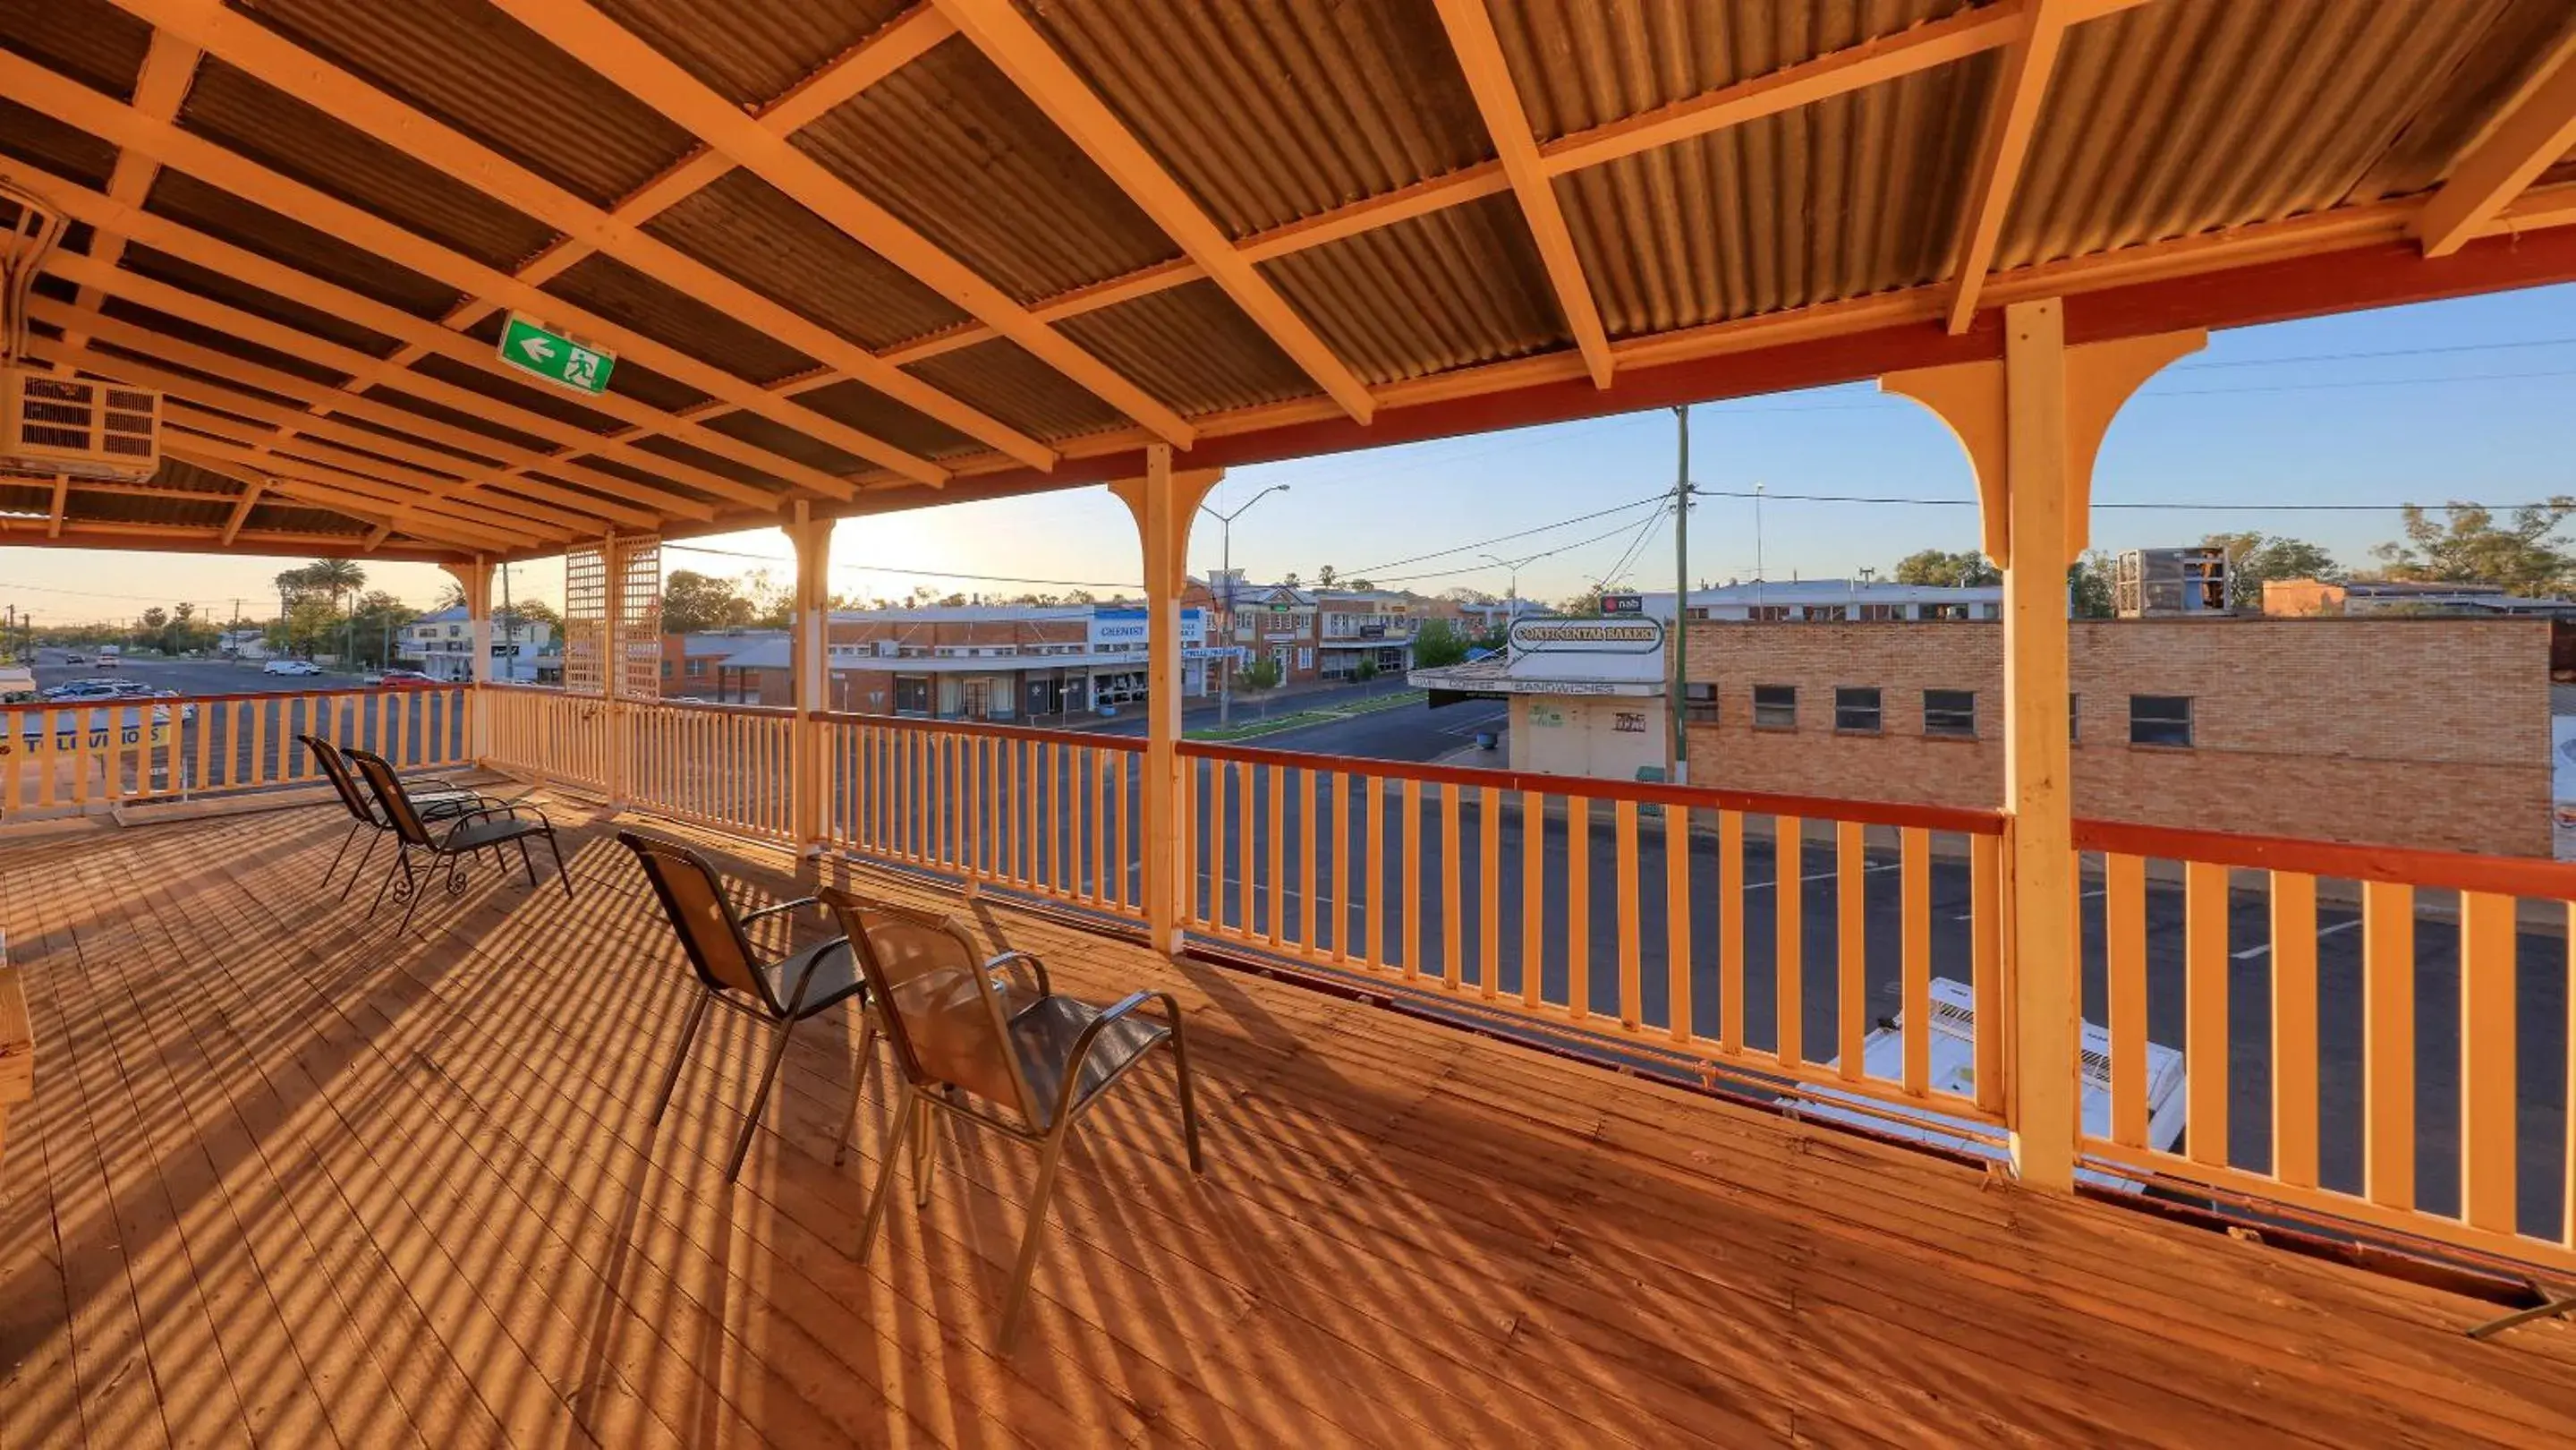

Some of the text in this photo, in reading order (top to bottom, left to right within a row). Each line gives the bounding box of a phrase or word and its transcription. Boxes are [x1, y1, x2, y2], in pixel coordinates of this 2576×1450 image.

[1619, 597, 1639, 609] nab
[1514, 627, 1656, 642] CONTINENTAL BAKERY
[1514, 683, 1616, 694] SANDWICHES
[23, 728, 159, 753] TLVIIOS
